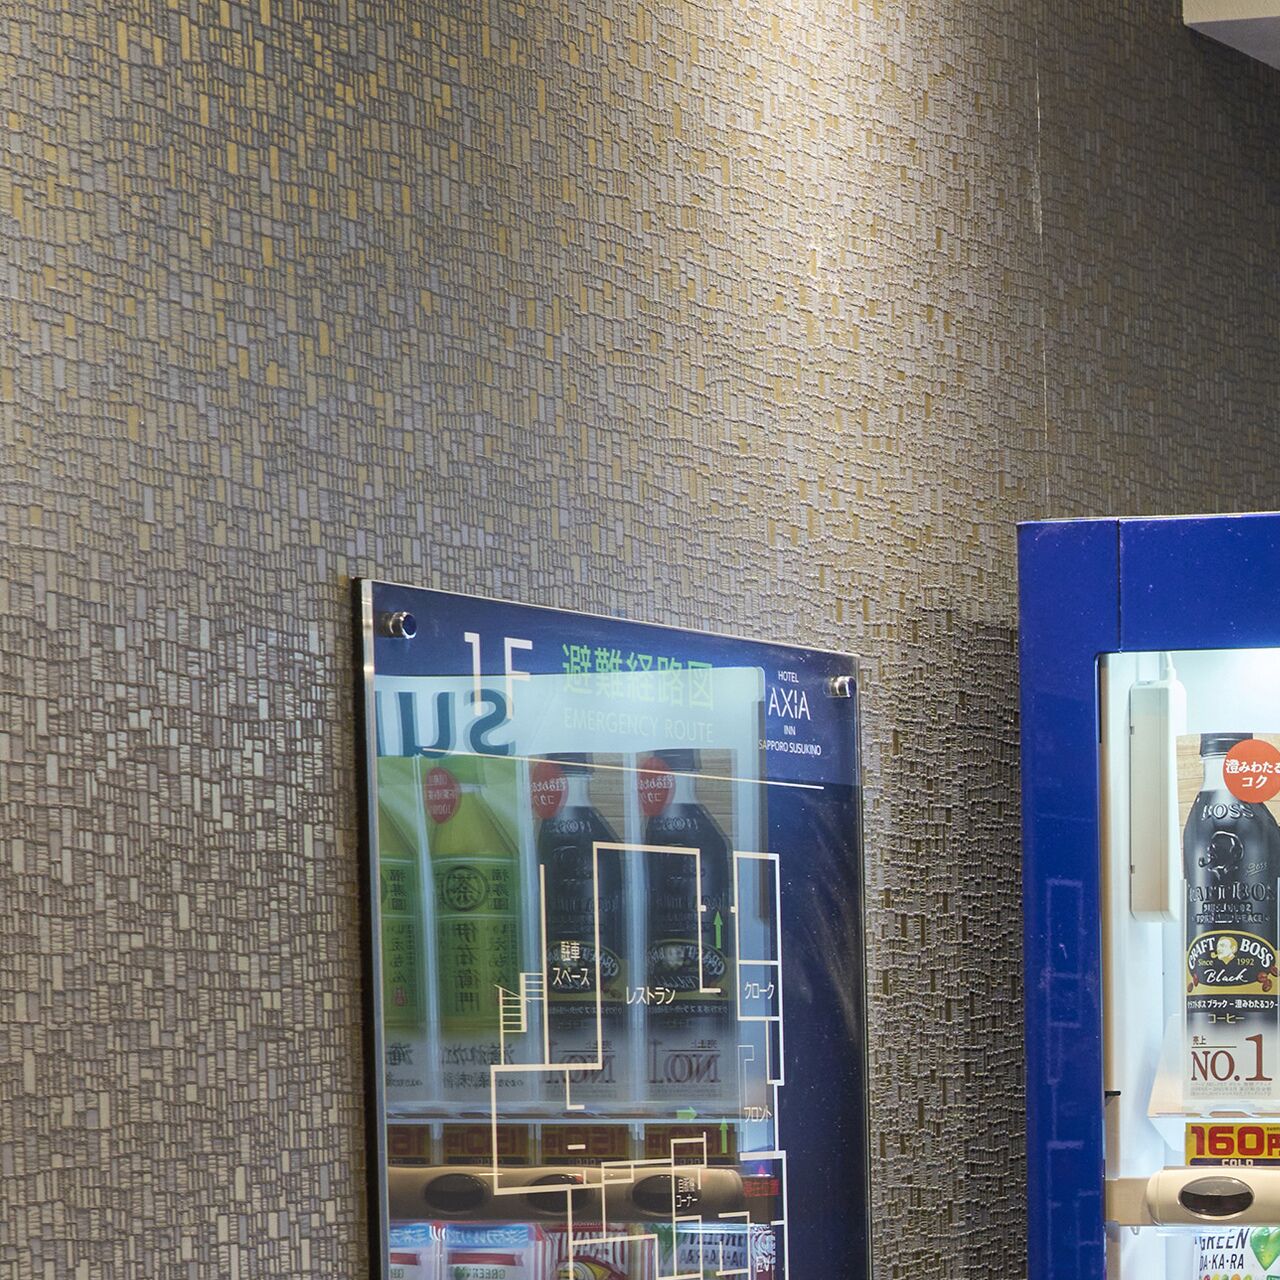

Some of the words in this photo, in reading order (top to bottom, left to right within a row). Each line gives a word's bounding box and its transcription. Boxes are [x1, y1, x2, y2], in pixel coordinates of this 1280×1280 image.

[562, 644, 714, 712] 避難経路図
[778, 671, 799, 683] HOTEL
[564, 708, 659, 738] EMERGENCY
[664, 716, 714, 744] ROUTE
[784, 725, 796, 735] INN
[759, 740, 788, 752] SAPPORO
[789, 742, 821, 755] SUSUKINO
[1242, 774, 1268, 789] コク
[1188, 937, 1215, 969] CRAFT
[1240, 938, 1274, 968] BOSS
[552, 968, 590, 987] スペース
[1204, 969, 1248, 983] Black
[626, 986, 675, 1006] レストラン
[744, 982, 774, 1000] クローク
[1207, 1013, 1245, 1023] コーヒー
[1191, 1034, 1273, 1082] NO.1
[744, 1106, 772, 1123] フロント
